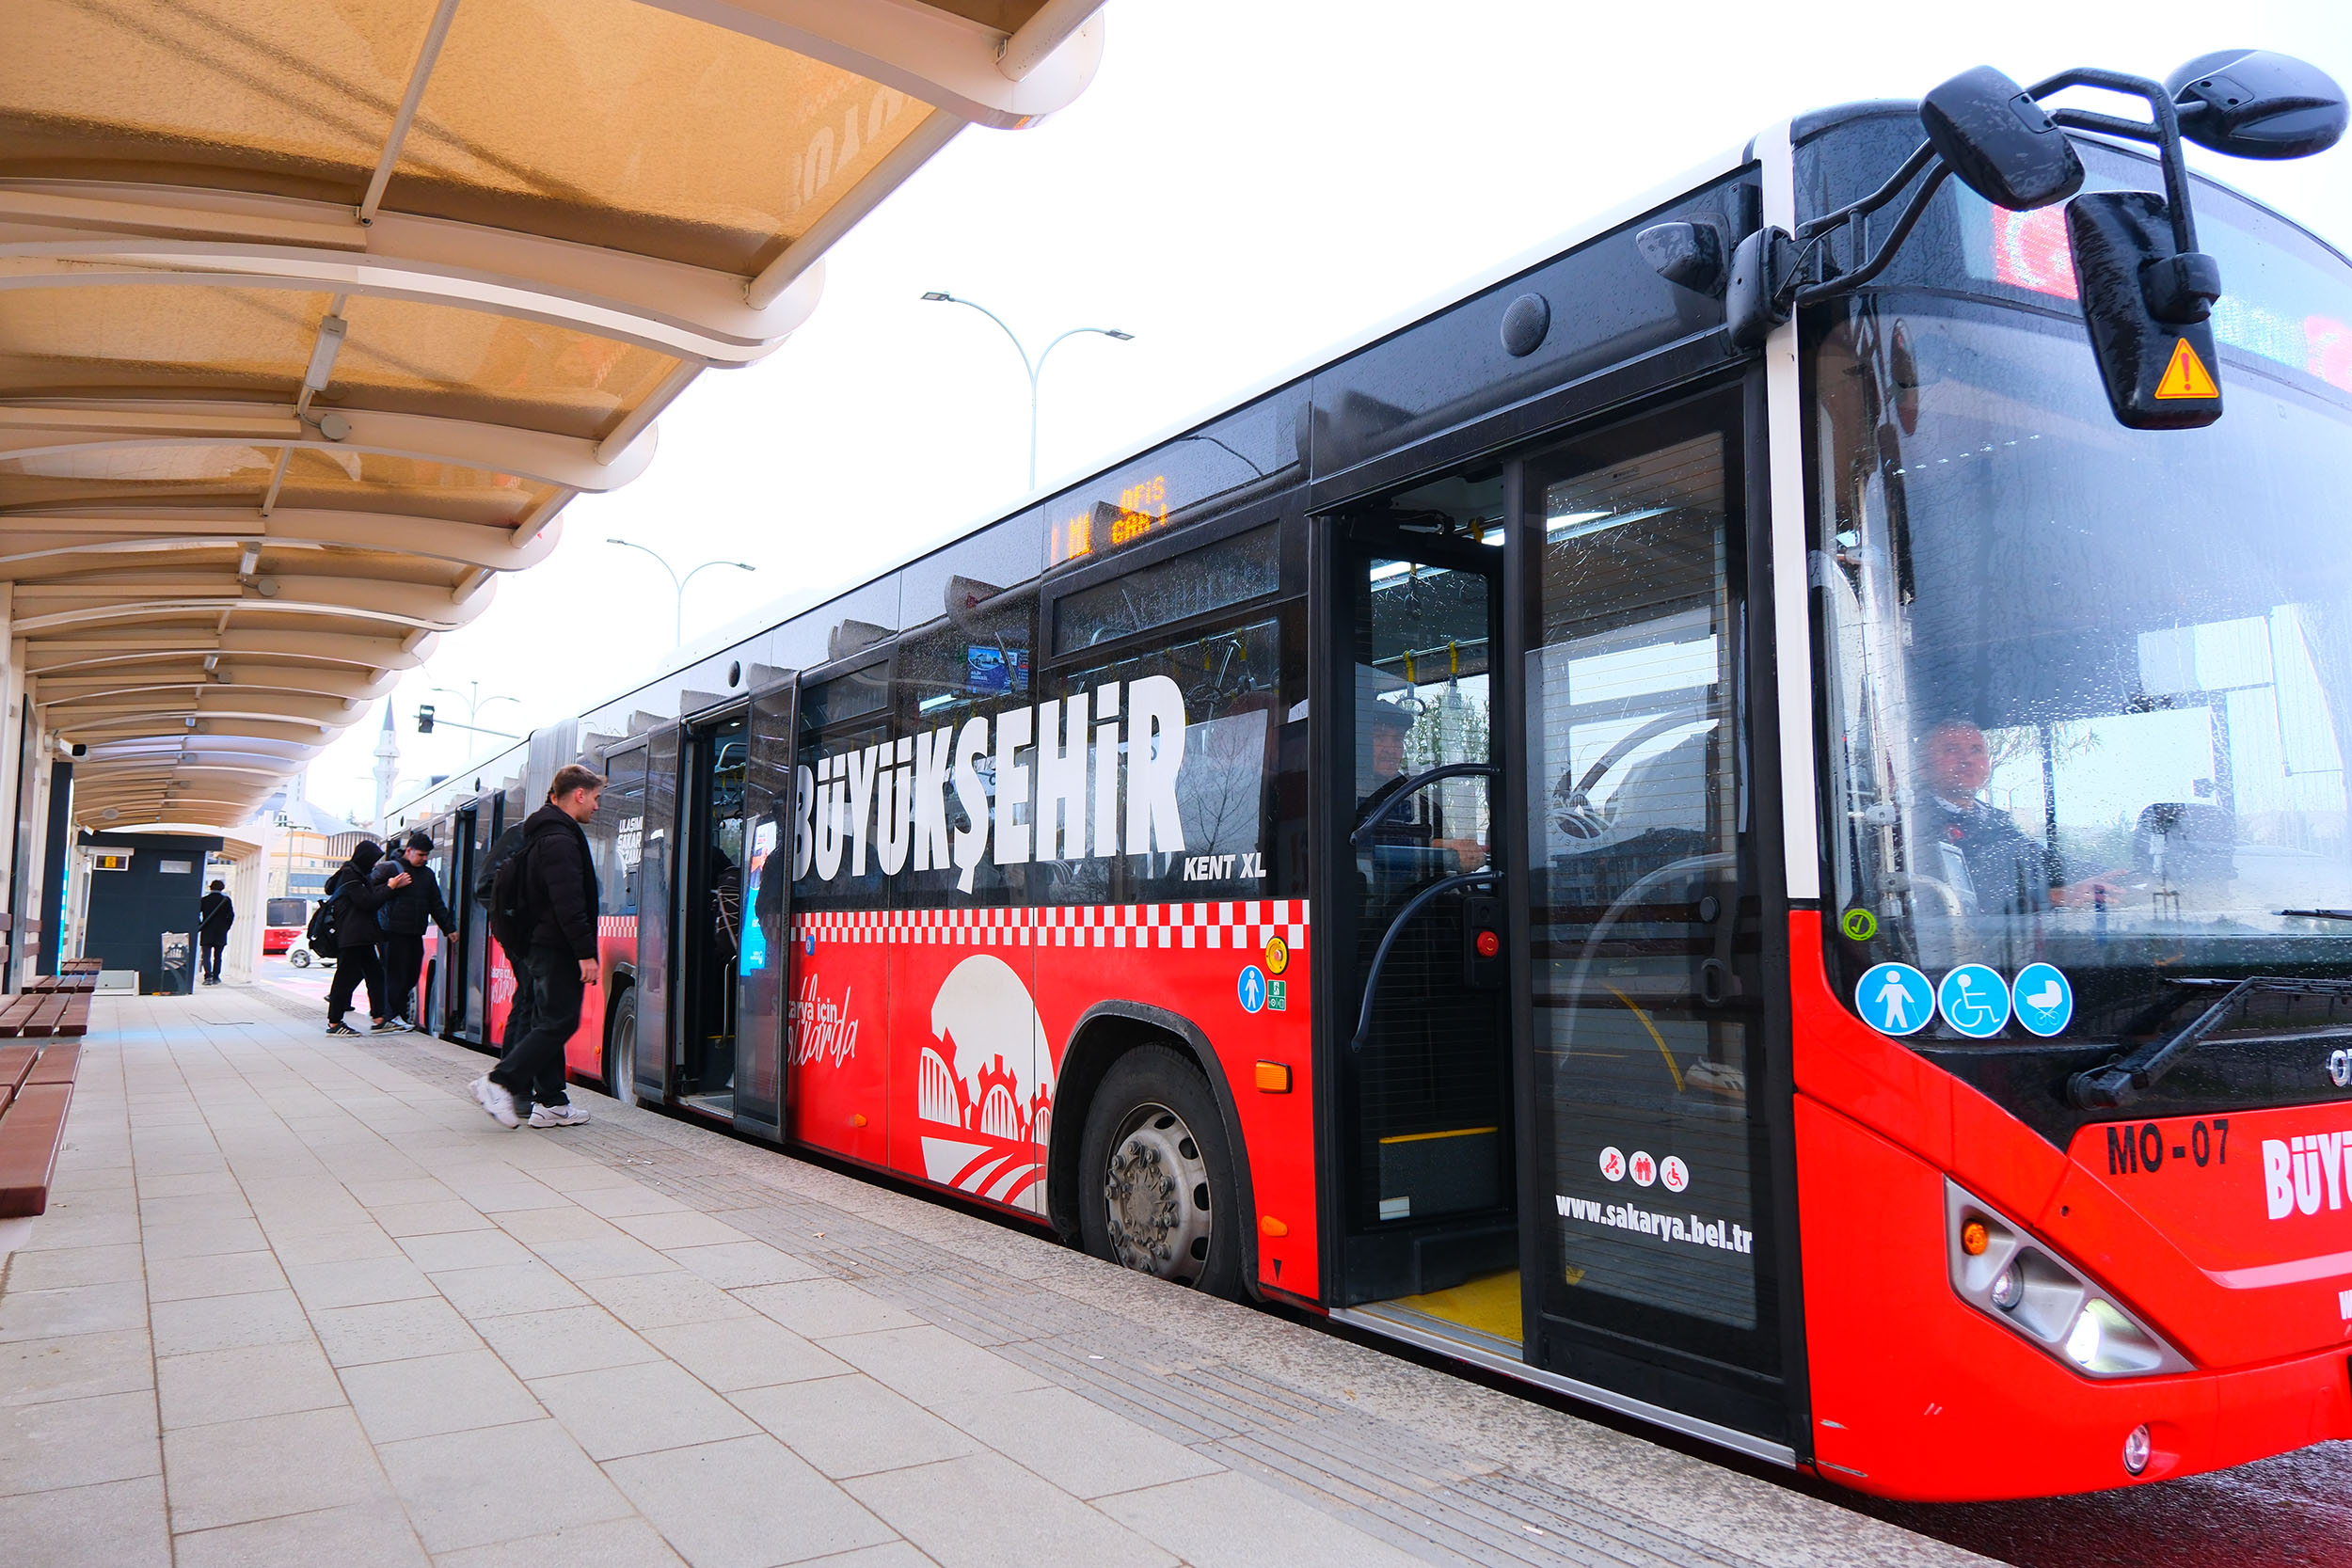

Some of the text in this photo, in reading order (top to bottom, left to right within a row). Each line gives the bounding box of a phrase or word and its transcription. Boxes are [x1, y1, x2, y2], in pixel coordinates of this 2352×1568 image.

[1184, 852, 1266, 881] KENT XL
[1555, 1194, 1754, 1254] www.sakarya.bel.tr
